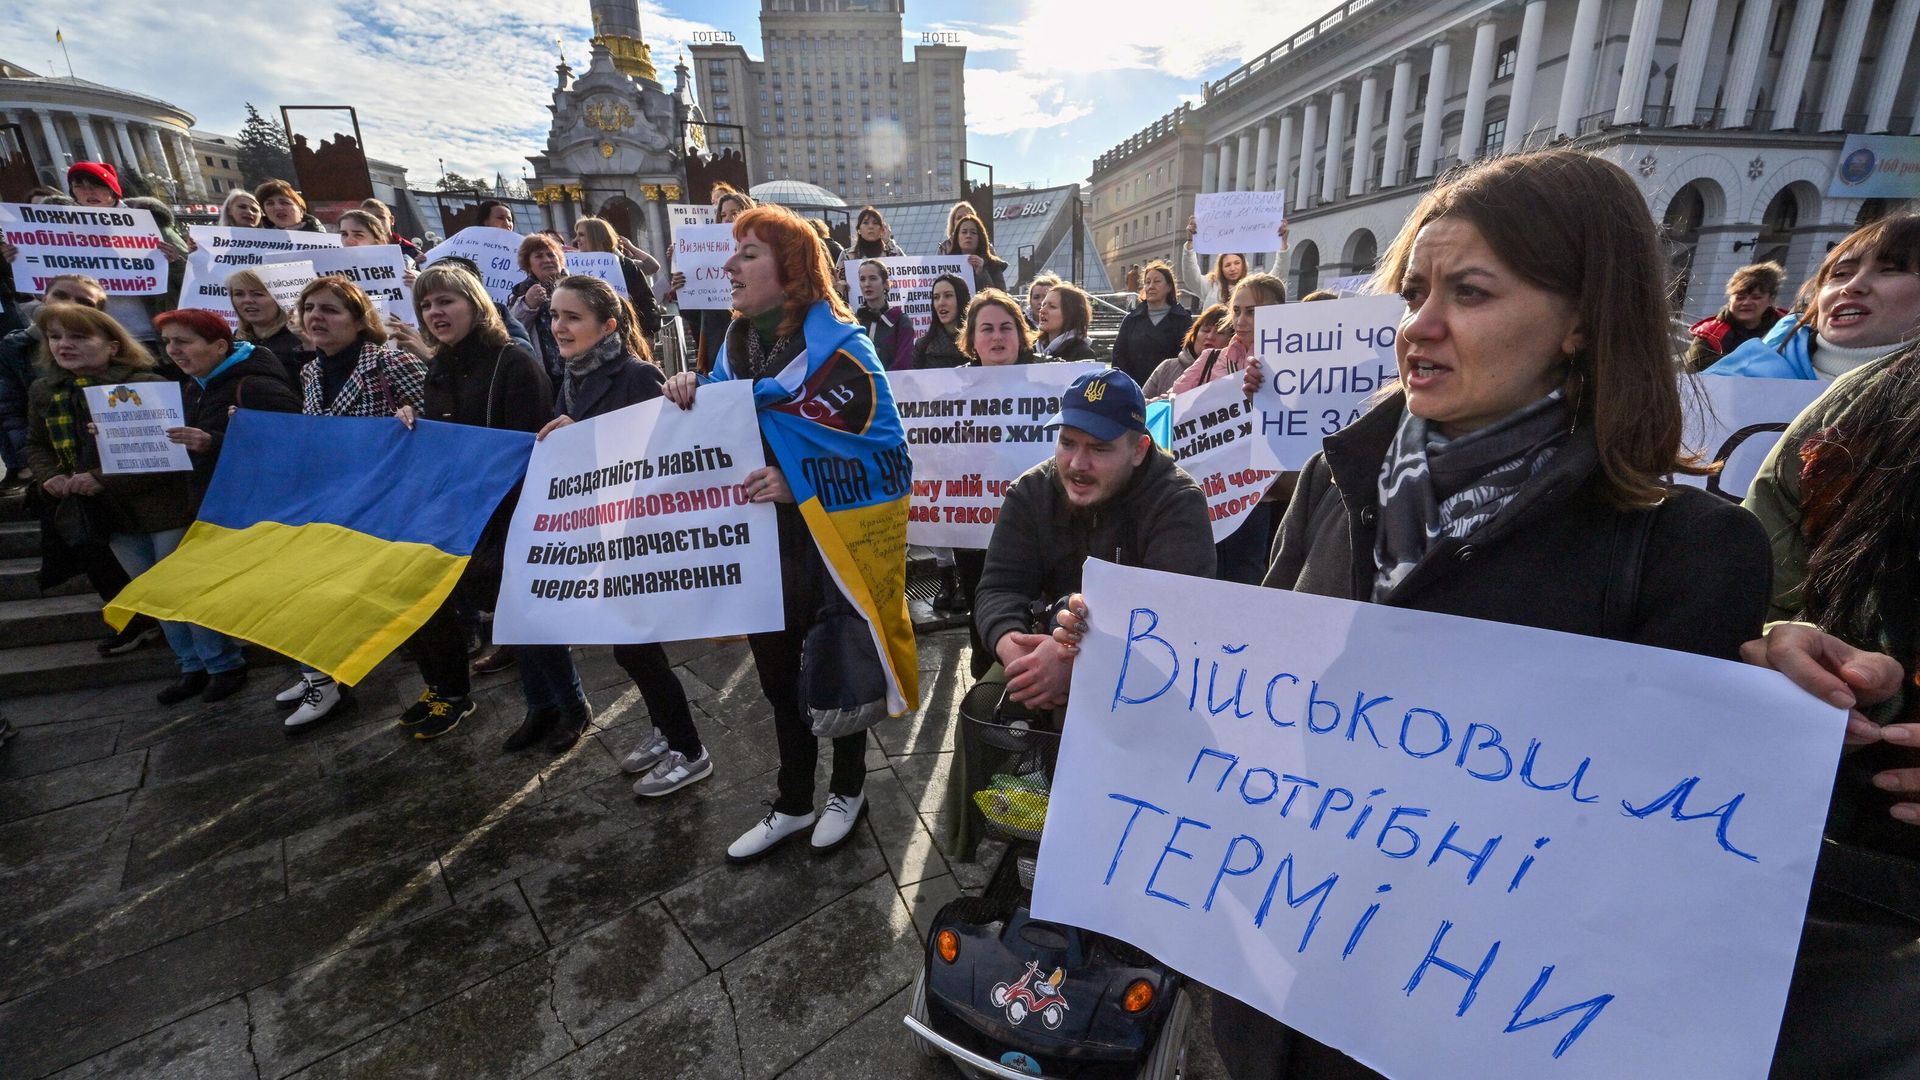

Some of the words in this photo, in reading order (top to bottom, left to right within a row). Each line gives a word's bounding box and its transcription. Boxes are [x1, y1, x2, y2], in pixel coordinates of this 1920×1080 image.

[692, 31, 736, 43] ГОТЕЛЬ
[921, 32, 961, 43] HOTEL
[19, 206, 135, 227] Пожиттєво
[6, 230, 160, 249] мобілізований
[212, 236, 294, 251] Визначений
[42, 254, 155, 271] пожиттєво
[214, 253, 263, 266] служби
[491, 257, 511, 271] 610
[361, 265, 396, 279] теж
[897, 265, 930, 276] ЗБРОЄЮ
[931, 265, 937, 275] В
[1260, 323, 1342, 355] Наші
[970, 397, 1013, 416] має
[1200, 403, 1240, 430] має
[907, 420, 1002, 444] спокійне
[1262, 410, 1308, 436] НЕ
[548, 459, 654, 500] Боєздатність
[658, 445, 733, 471] навіть
[945, 474, 983, 498] мій
[1200, 472, 1227, 498] ій
[533, 483, 751, 532] високомотивованого
[527, 540, 606, 566] війська
[608, 523, 750, 561] втрачається
[531, 578, 598, 601] через
[603, 563, 741, 598] виснаження
